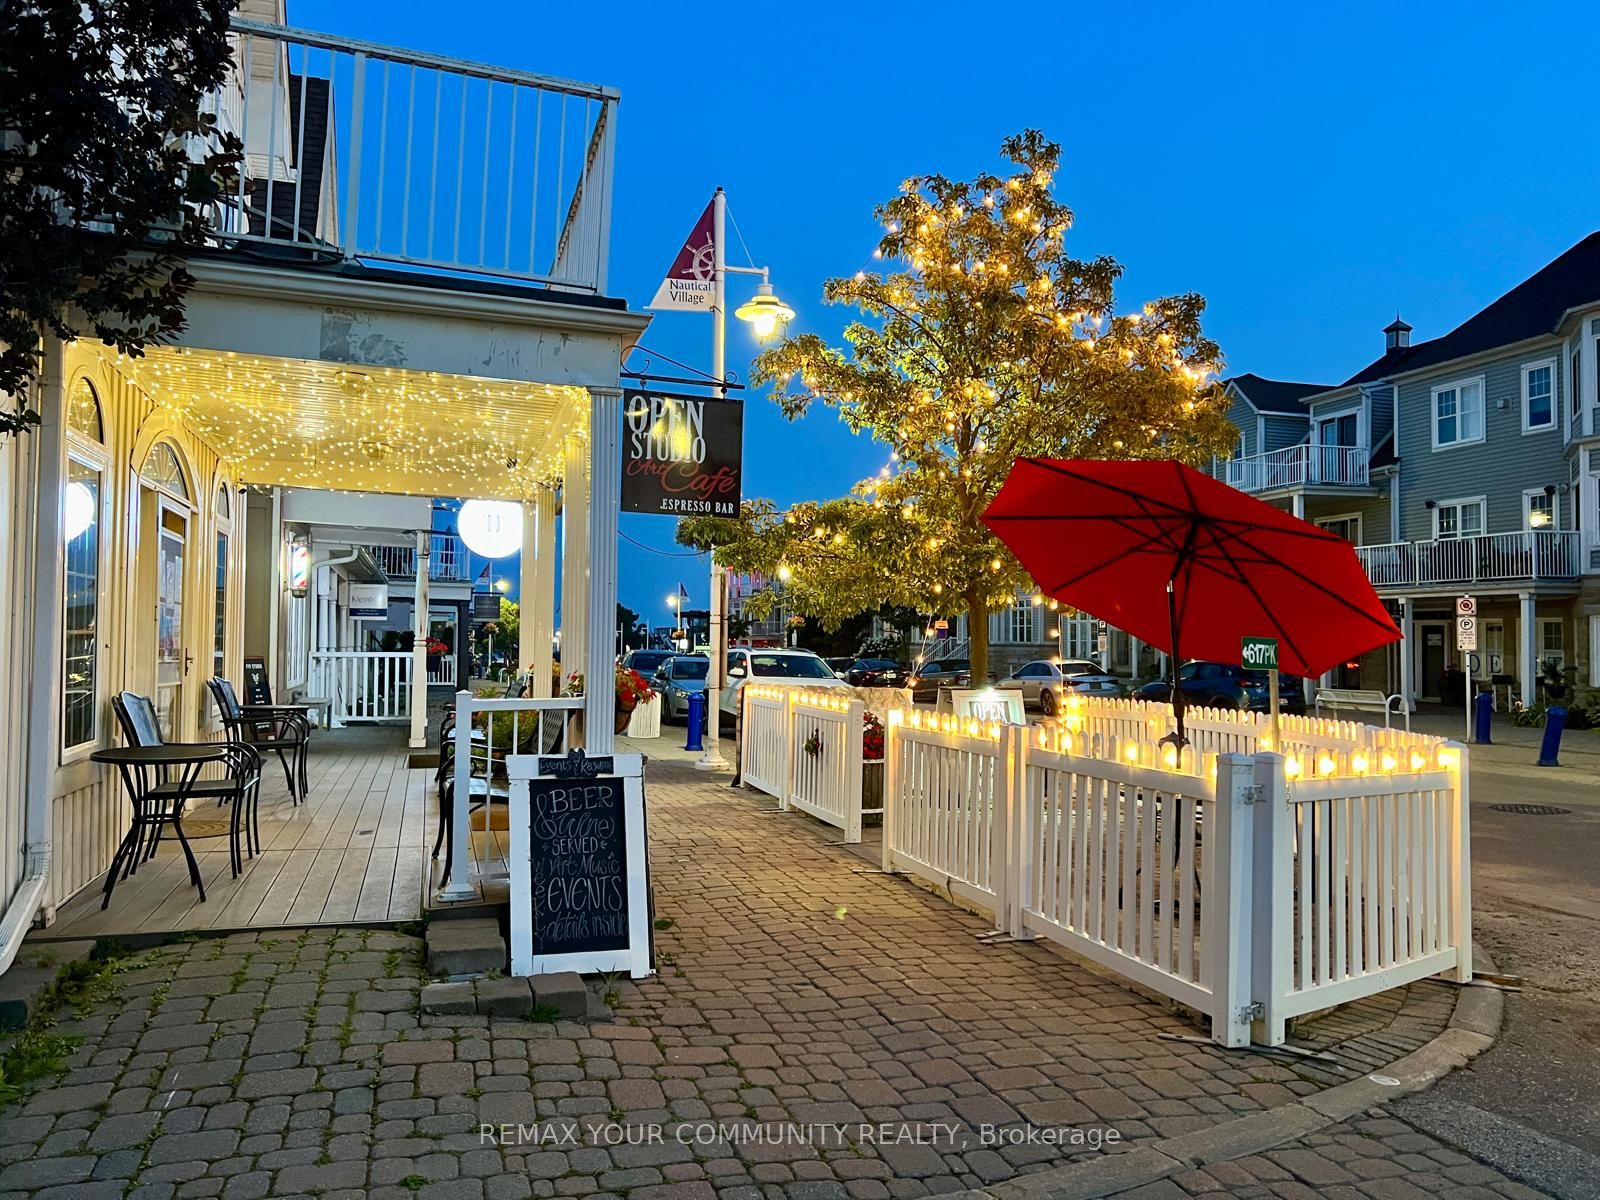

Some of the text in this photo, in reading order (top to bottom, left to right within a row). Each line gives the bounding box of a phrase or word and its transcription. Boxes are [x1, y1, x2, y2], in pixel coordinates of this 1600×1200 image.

[670, 279, 711, 291] Nautical
[670, 291, 704, 304] Village
[628, 395, 704, 438] OPEN
[631, 432, 706, 463] STUDIO
[661, 461, 738, 500] Café
[662, 499, 734, 514] ESPRESSO BAR
[973, 701, 1008, 724] OPEN
[540, 759, 572, 773] Events
[549, 785, 613, 813] BEER
[552, 836, 598, 855] SERVED
[578, 853, 620, 877] Music
[547, 876, 623, 912] EVENTS
